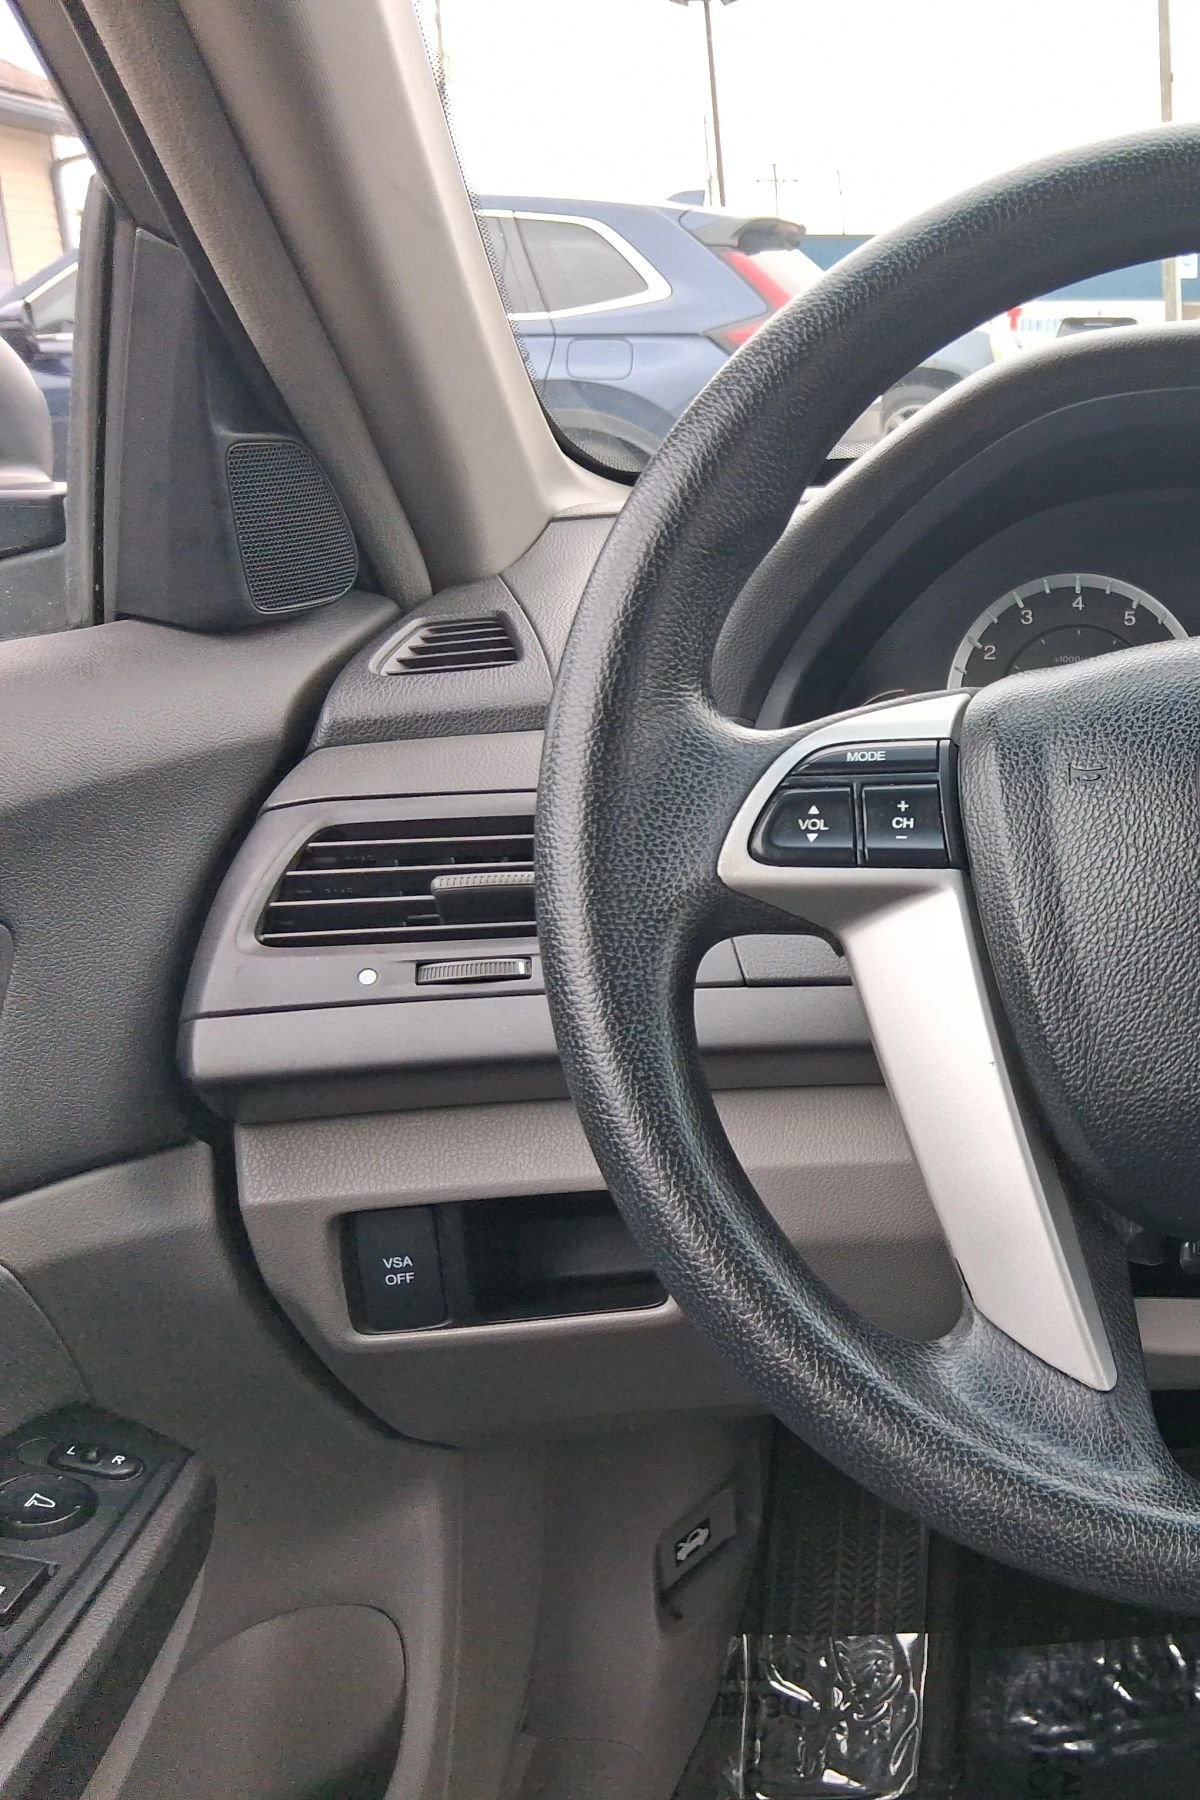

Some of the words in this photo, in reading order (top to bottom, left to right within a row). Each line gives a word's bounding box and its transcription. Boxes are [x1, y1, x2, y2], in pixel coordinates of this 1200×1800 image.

[1072, 596, 1084, 611] 4
[1020, 609, 1033, 625] 3
[1123, 610, 1136, 626] 5
[983, 645, 996, 660] 2
[846, 751, 886, 762] MODE
[798, 818, 829, 831] VOL
[891, 817, 914, 829] CH
[382, 1255, 413, 1269] VSA
[385, 1272, 415, 1286] OFF
[66, 1445, 76, 1456] L
[111, 1454, 126, 1465] R
